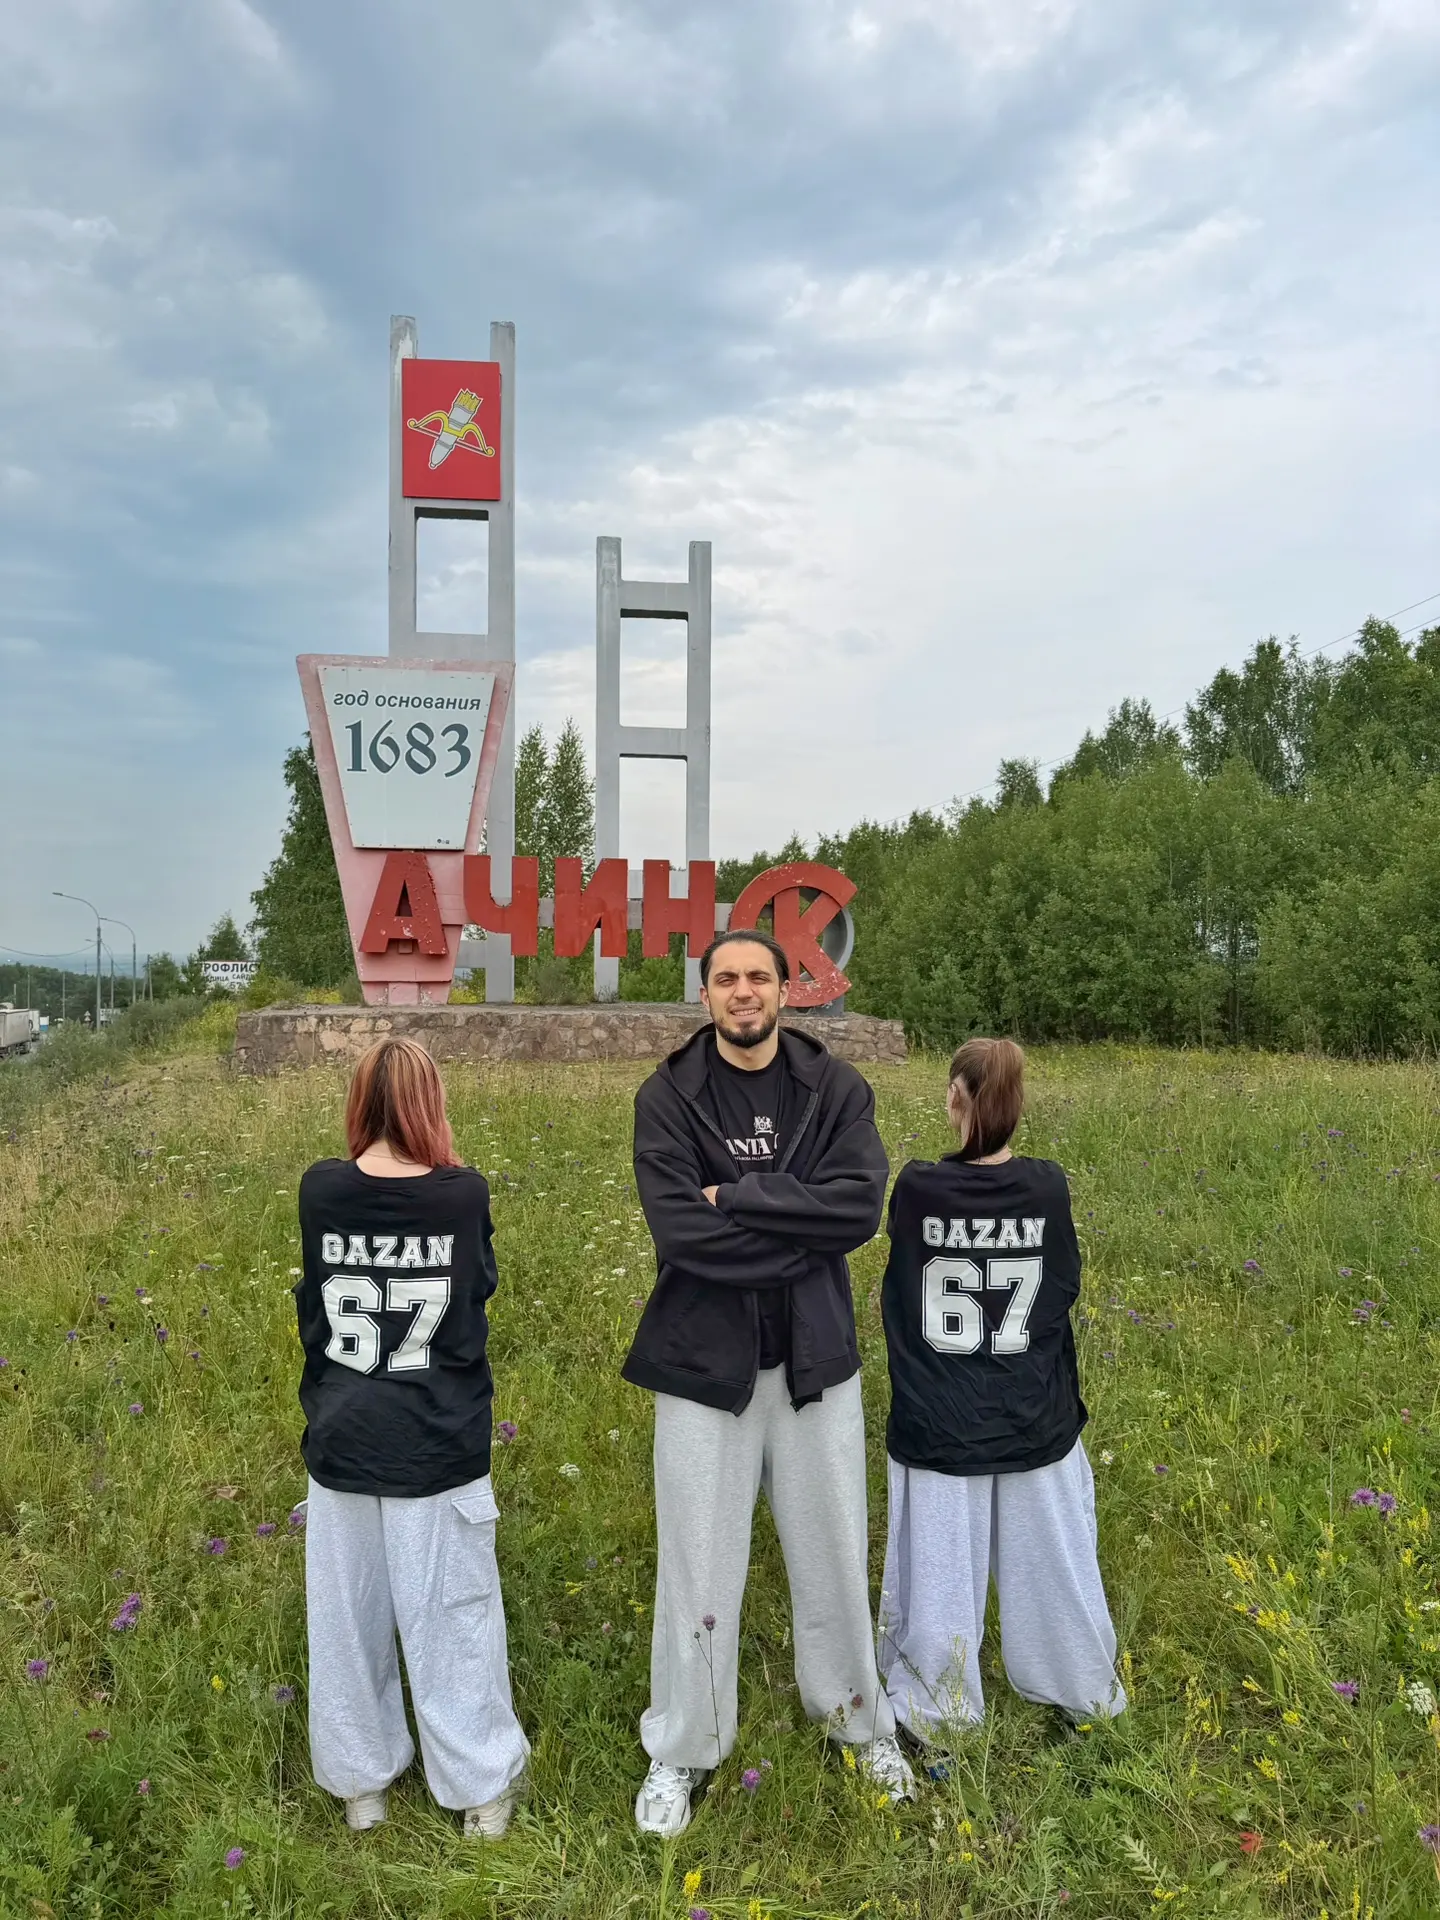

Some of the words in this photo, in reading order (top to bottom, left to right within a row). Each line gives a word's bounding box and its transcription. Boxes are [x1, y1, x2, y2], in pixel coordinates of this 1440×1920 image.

[333, 690, 369, 707] год
[375, 693, 481, 711] основания
[344, 719, 473, 778] 1683
[321, 1232, 454, 1268] GAZAN
[922, 1216, 1046, 1249] GAZAN
[321, 1274, 452, 1375] 67
[922, 1256, 1043, 1355] 67
